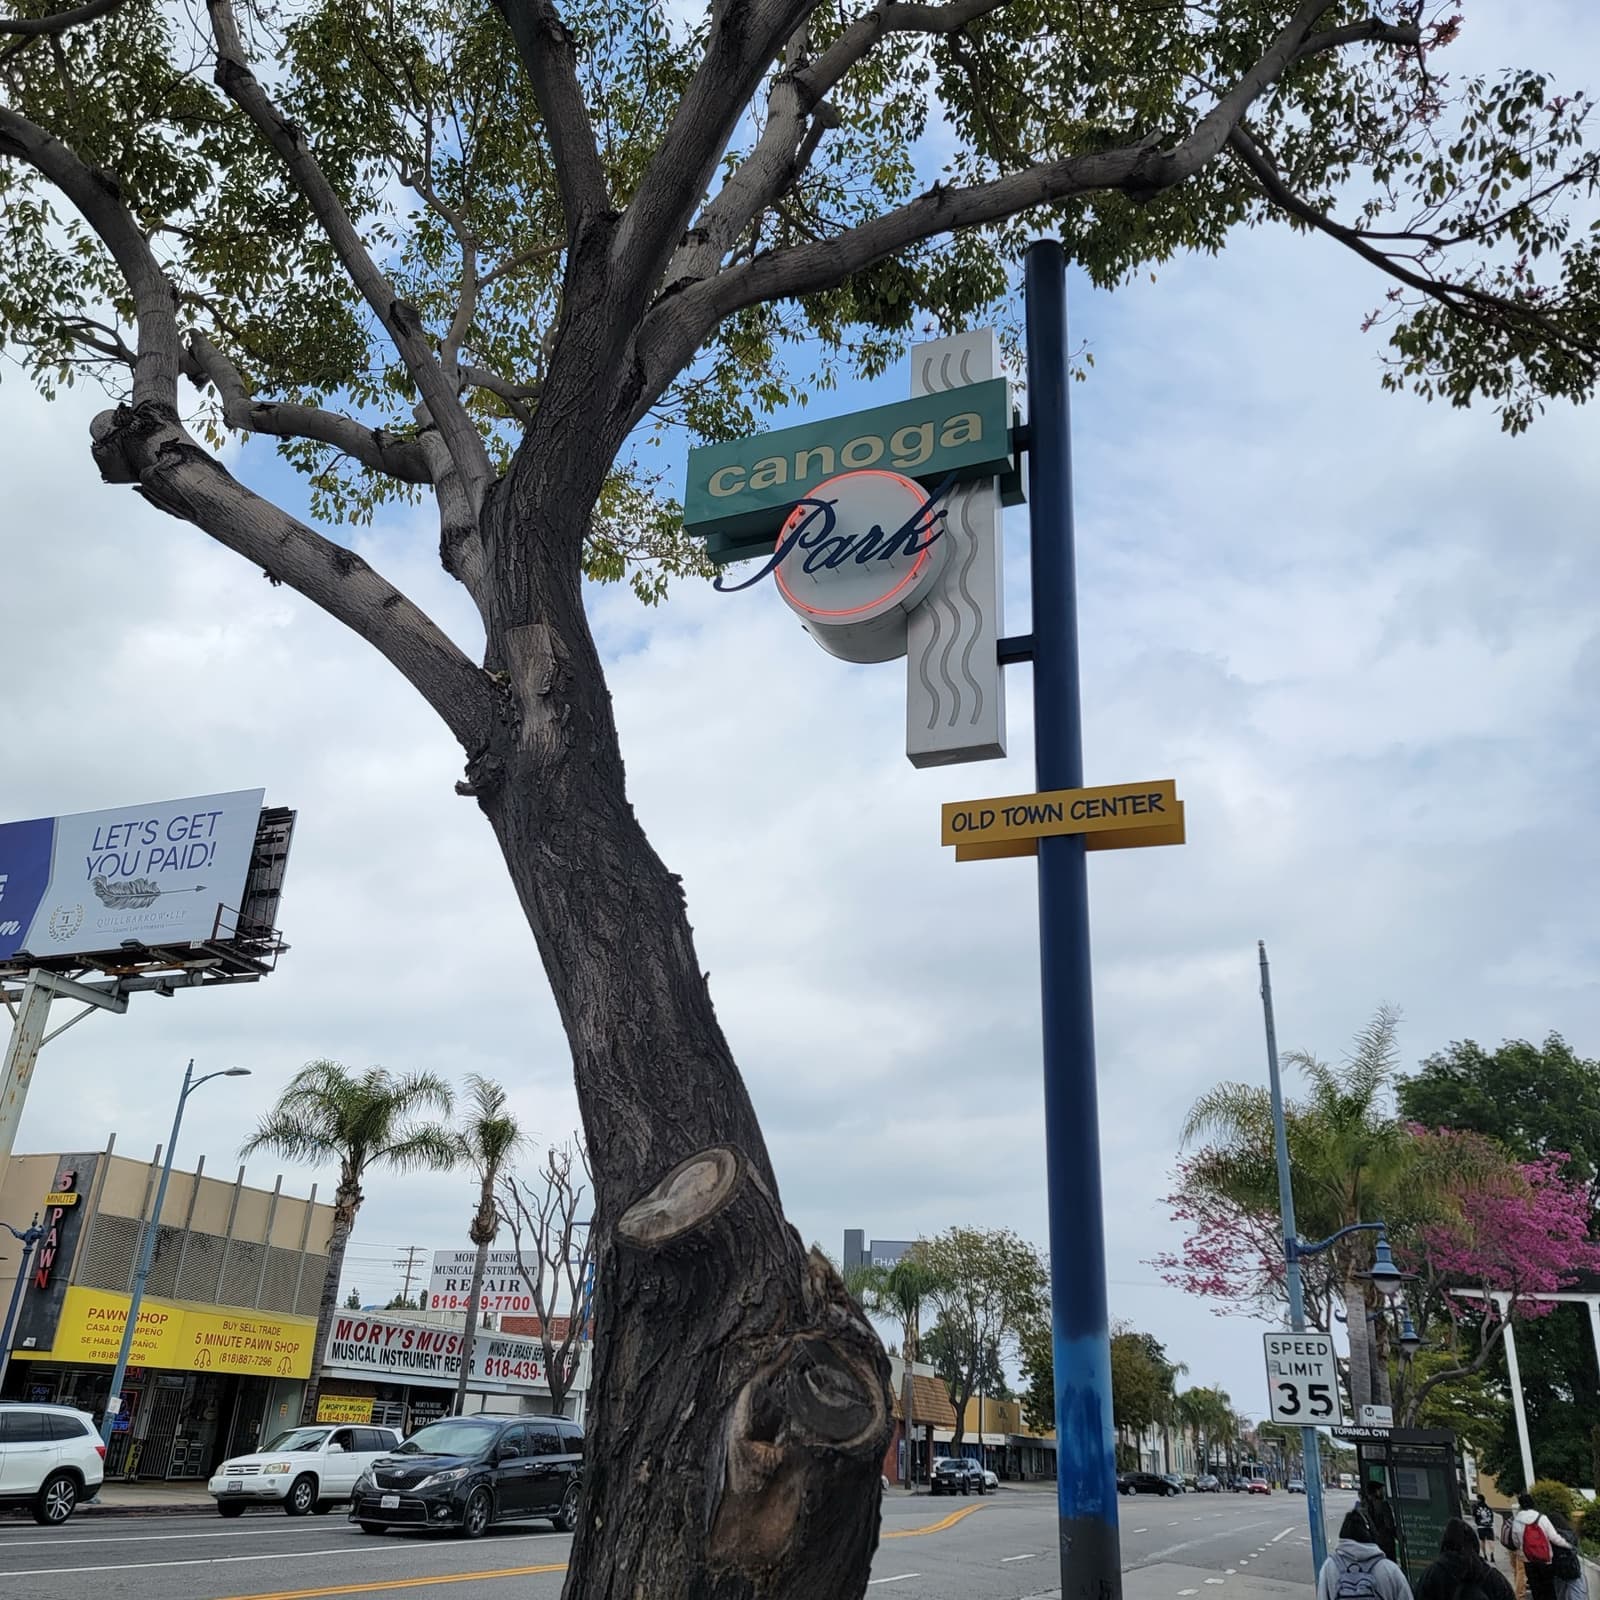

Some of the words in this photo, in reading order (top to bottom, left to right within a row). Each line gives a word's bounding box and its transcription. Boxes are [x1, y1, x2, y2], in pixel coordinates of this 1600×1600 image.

[707, 412, 983, 498] canoga
[713, 470, 957, 592] Park
[951, 809, 995, 833] OLD
[1001, 802, 1063, 827] TOWN
[1070, 793, 1165, 821] CENTER
[91, 819, 160, 852] LET'S
[166, 811, 223, 842] GET
[86, 850, 141, 881] YOU
[146, 841, 217, 874] PAID!
[57, 1170, 75, 1192] 5
[46, 1193, 76, 1204] MINUTE
[434, 1265, 474, 1275] MUSICAL
[873, 1257, 902, 1267] CHA
[431, 1294, 530, 1311] 818-49-7700
[87, 1307, 128, 1321] PAWN
[86, 1322, 110, 1332] CASA
[112, 1325, 125, 1334] DE
[132, 1326, 164, 1337] MPEÑO
[223, 1320, 238, 1330] BUY
[240, 1322, 257, 1334] SELL
[259, 1325, 281, 1336] TRADE
[131, 1339, 159, 1350] PAÑOL
[195, 1332, 202, 1345] 5
[204, 1333, 243, 1348] MINUTE
[244, 1337, 273, 1351] PAWN
[274, 1340, 300, 1354] SHOP
[335, 1319, 415, 1349] MORY'S
[416, 1331, 477, 1356] MUSI
[1270, 1341, 1328, 1356] SPEED
[331, 1341, 377, 1363] MUSICAL
[379, 1347, 443, 1371] INSTRUMENT
[444, 1355, 476, 1375] REPR
[1279, 1362, 1323, 1376] LIMIT
[1278, 1382, 1333, 1417] 35
[1333, 1427, 1370, 1437] TOPANGA
[1371, 1429, 1390, 1437] CYN
